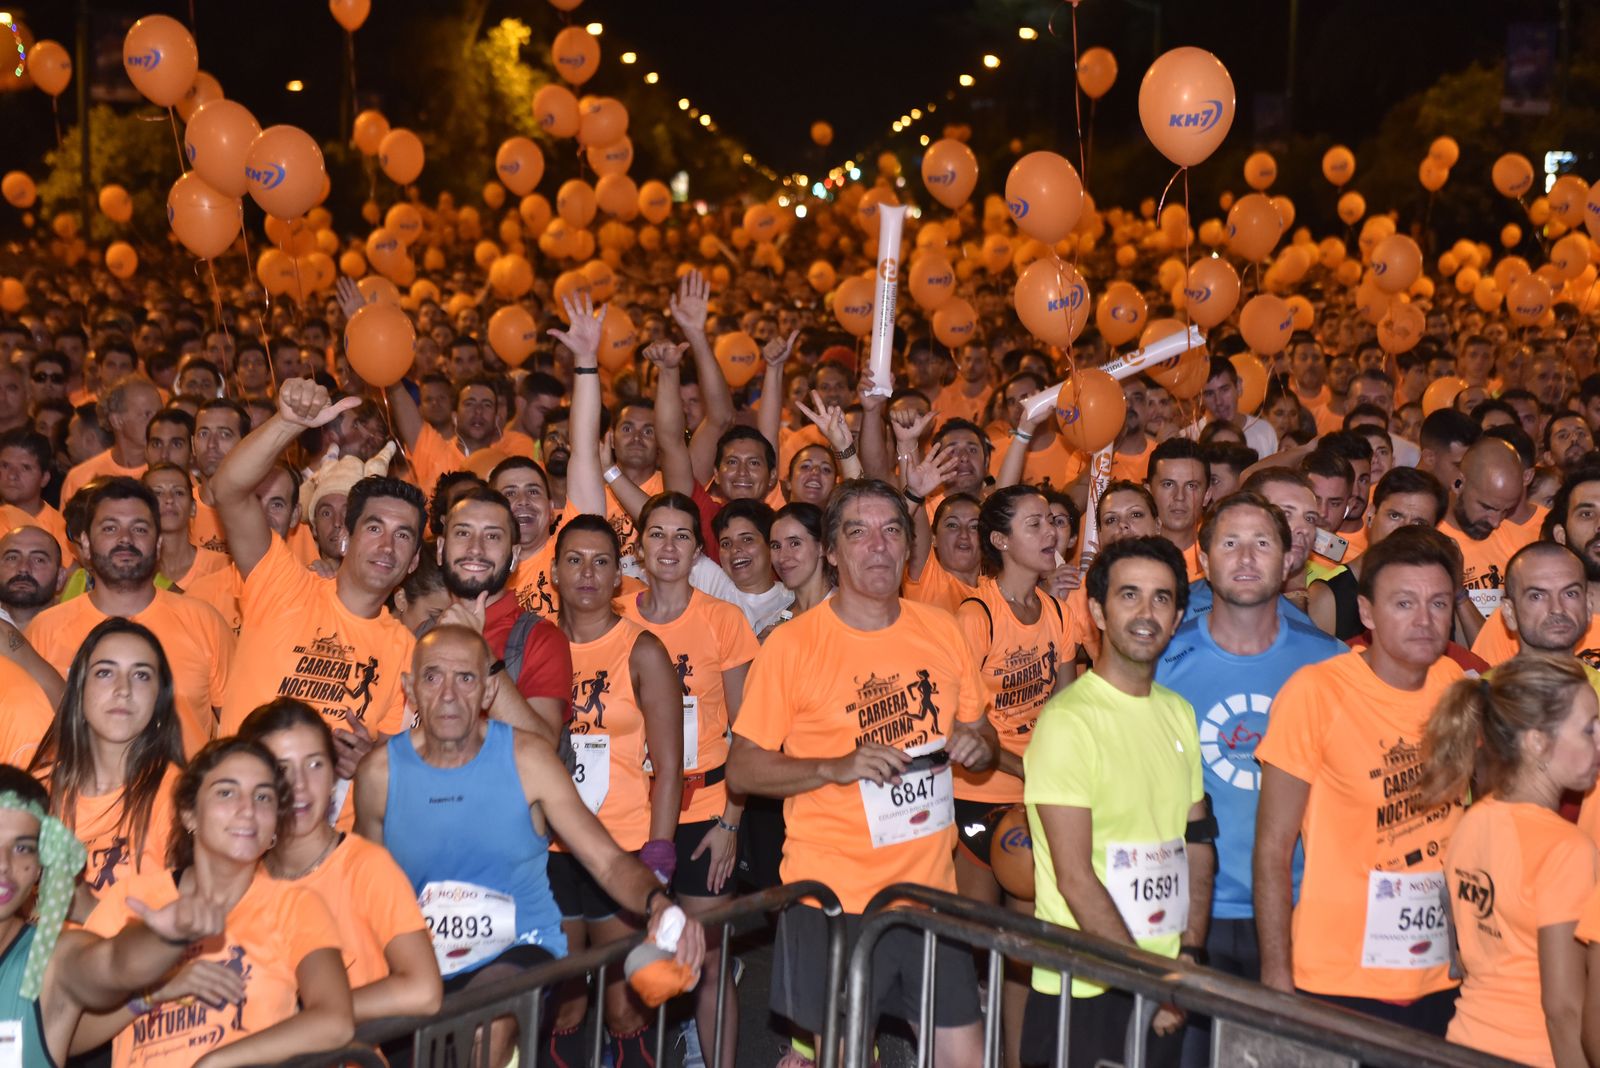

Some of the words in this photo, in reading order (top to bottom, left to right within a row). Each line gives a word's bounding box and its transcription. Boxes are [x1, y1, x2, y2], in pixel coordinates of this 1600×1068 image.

[295, 656, 352, 681] CARRERA
[1002, 660, 1043, 690] CARRERA
[277, 676, 345, 702] NOCTURNA
[995, 682, 1044, 709] NOCTURNA
[858, 691, 909, 729] CARRERA
[854, 717, 914, 748] NOCTURNA
[890, 774, 935, 807] 6847
[1130, 872, 1179, 901] 16591
[424, 915, 493, 939] 24893
[1398, 904, 1446, 931] 5462
